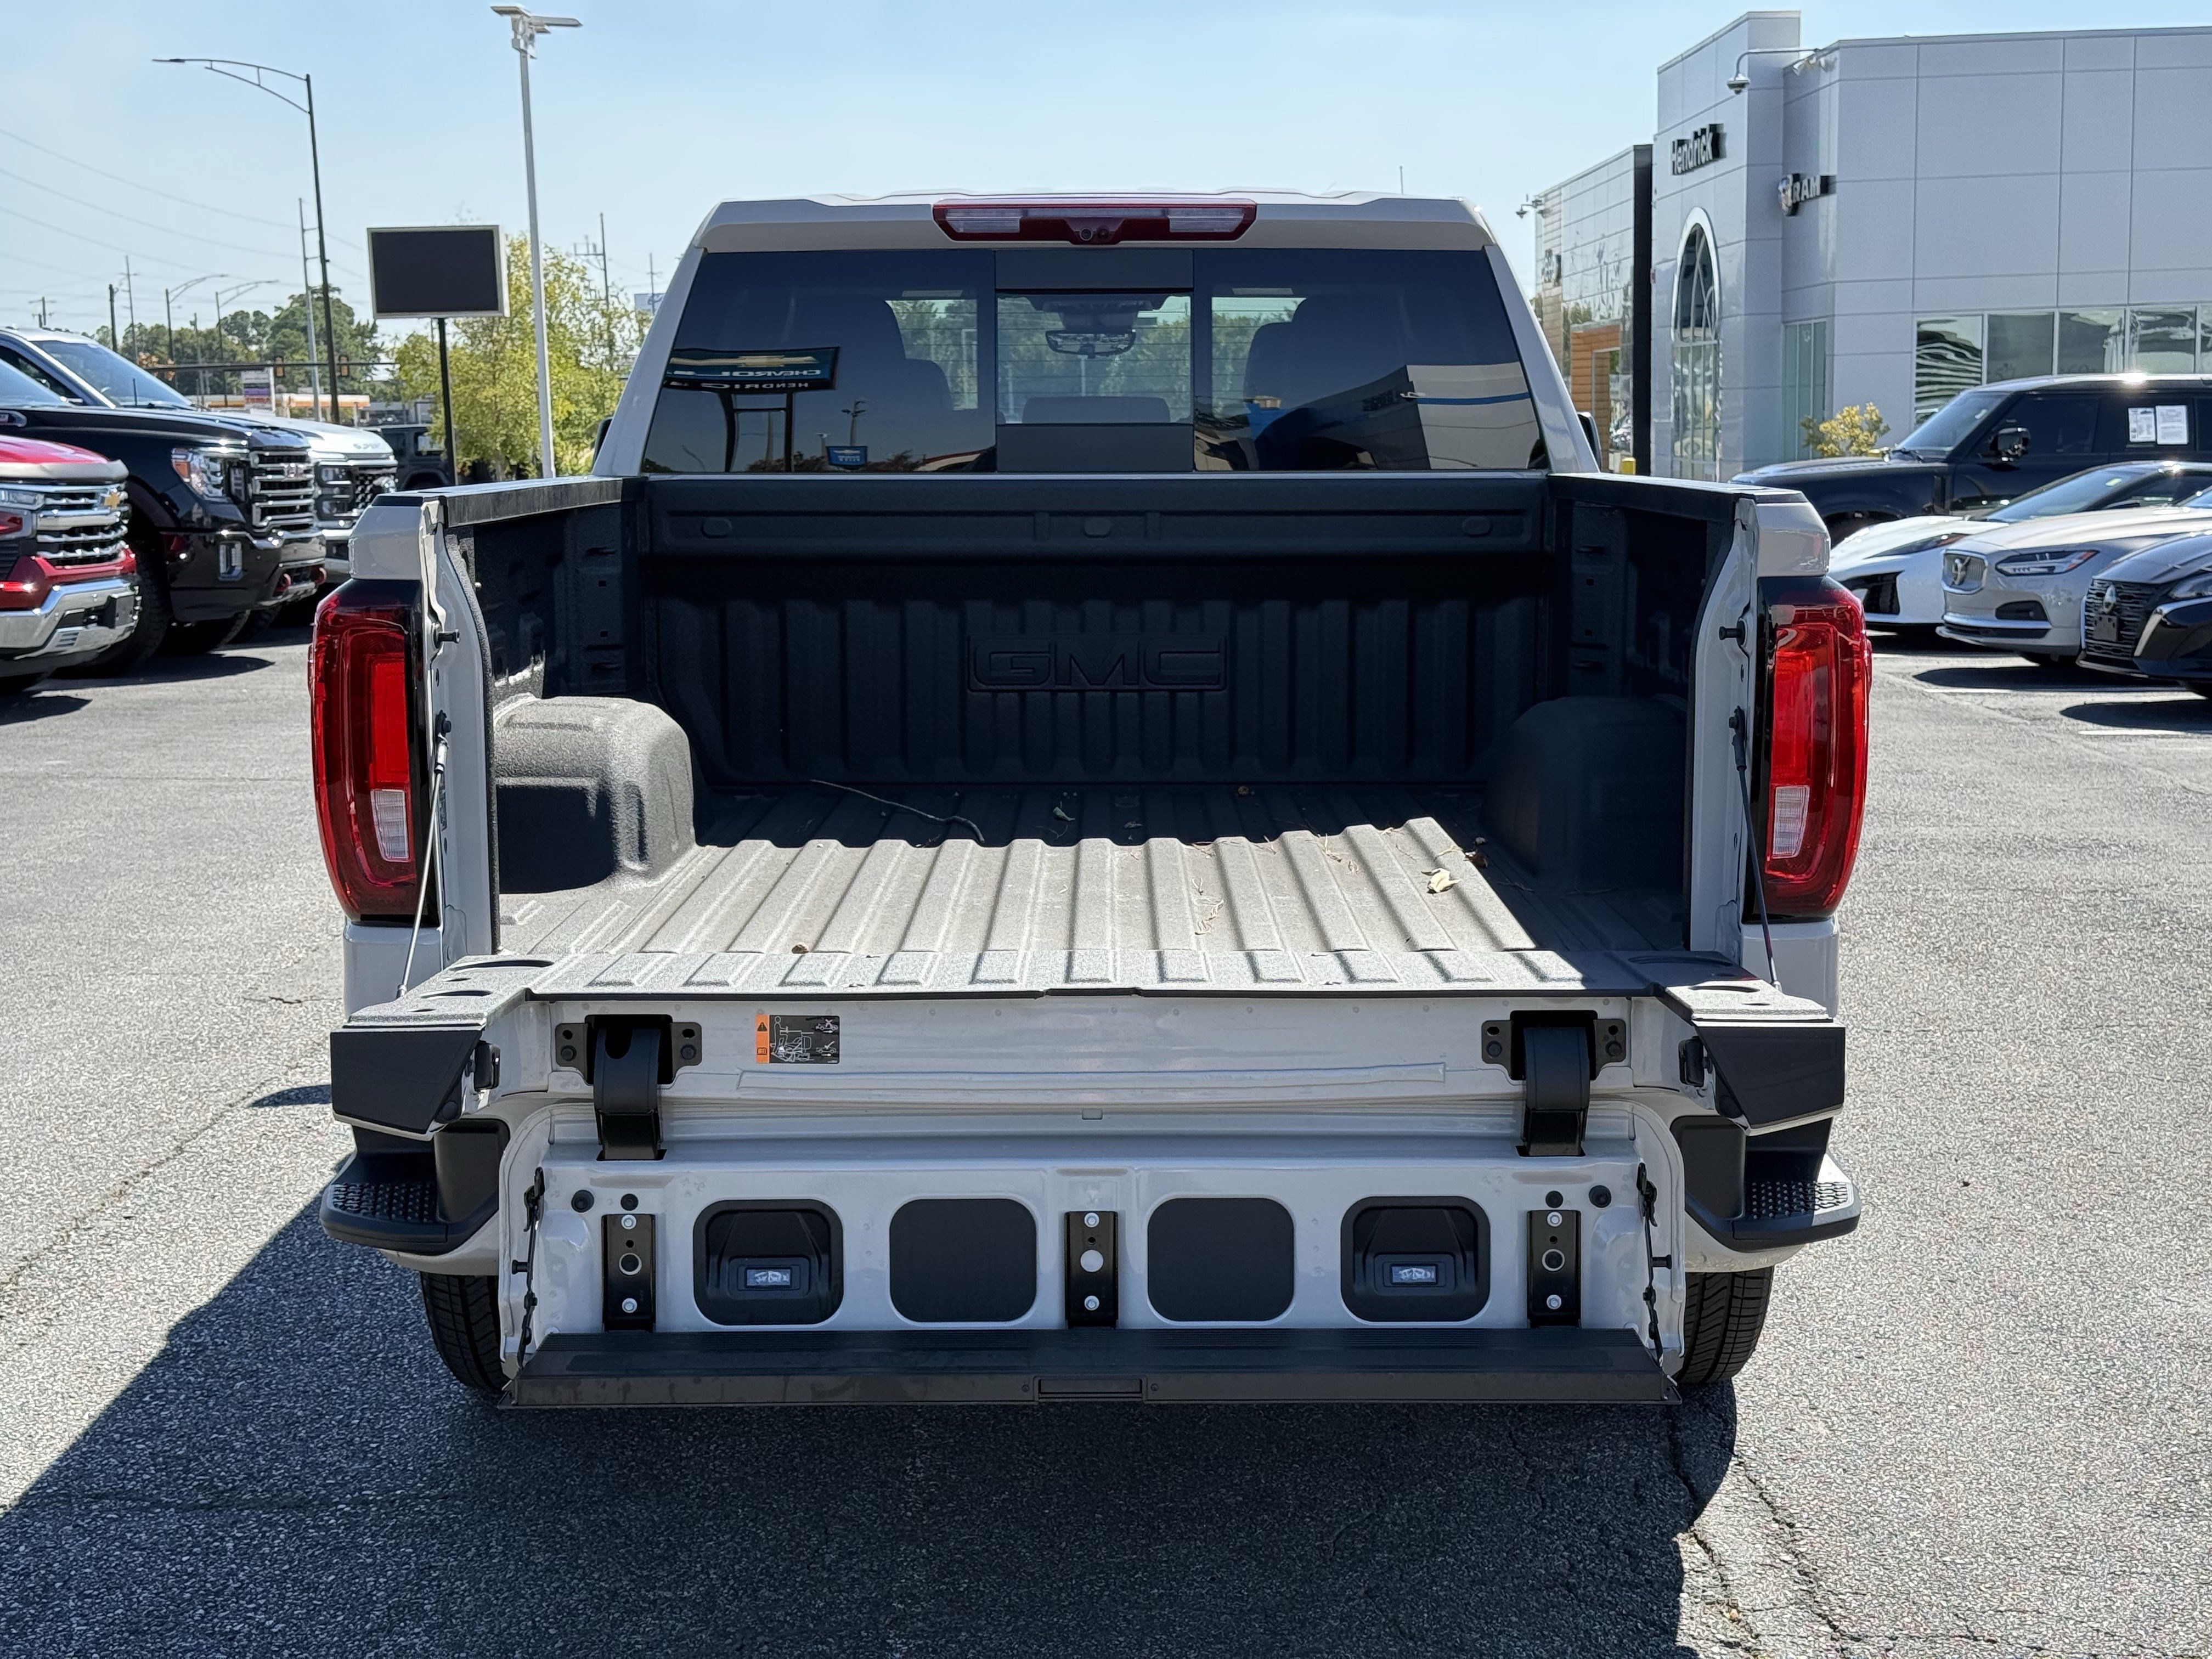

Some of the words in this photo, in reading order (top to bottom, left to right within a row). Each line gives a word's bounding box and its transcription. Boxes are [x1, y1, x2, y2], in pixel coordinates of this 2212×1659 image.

[1671, 125, 1713, 175] Hendrick
[1792, 176, 1821, 203] RAM
[973, 640, 1221, 686] GMC
